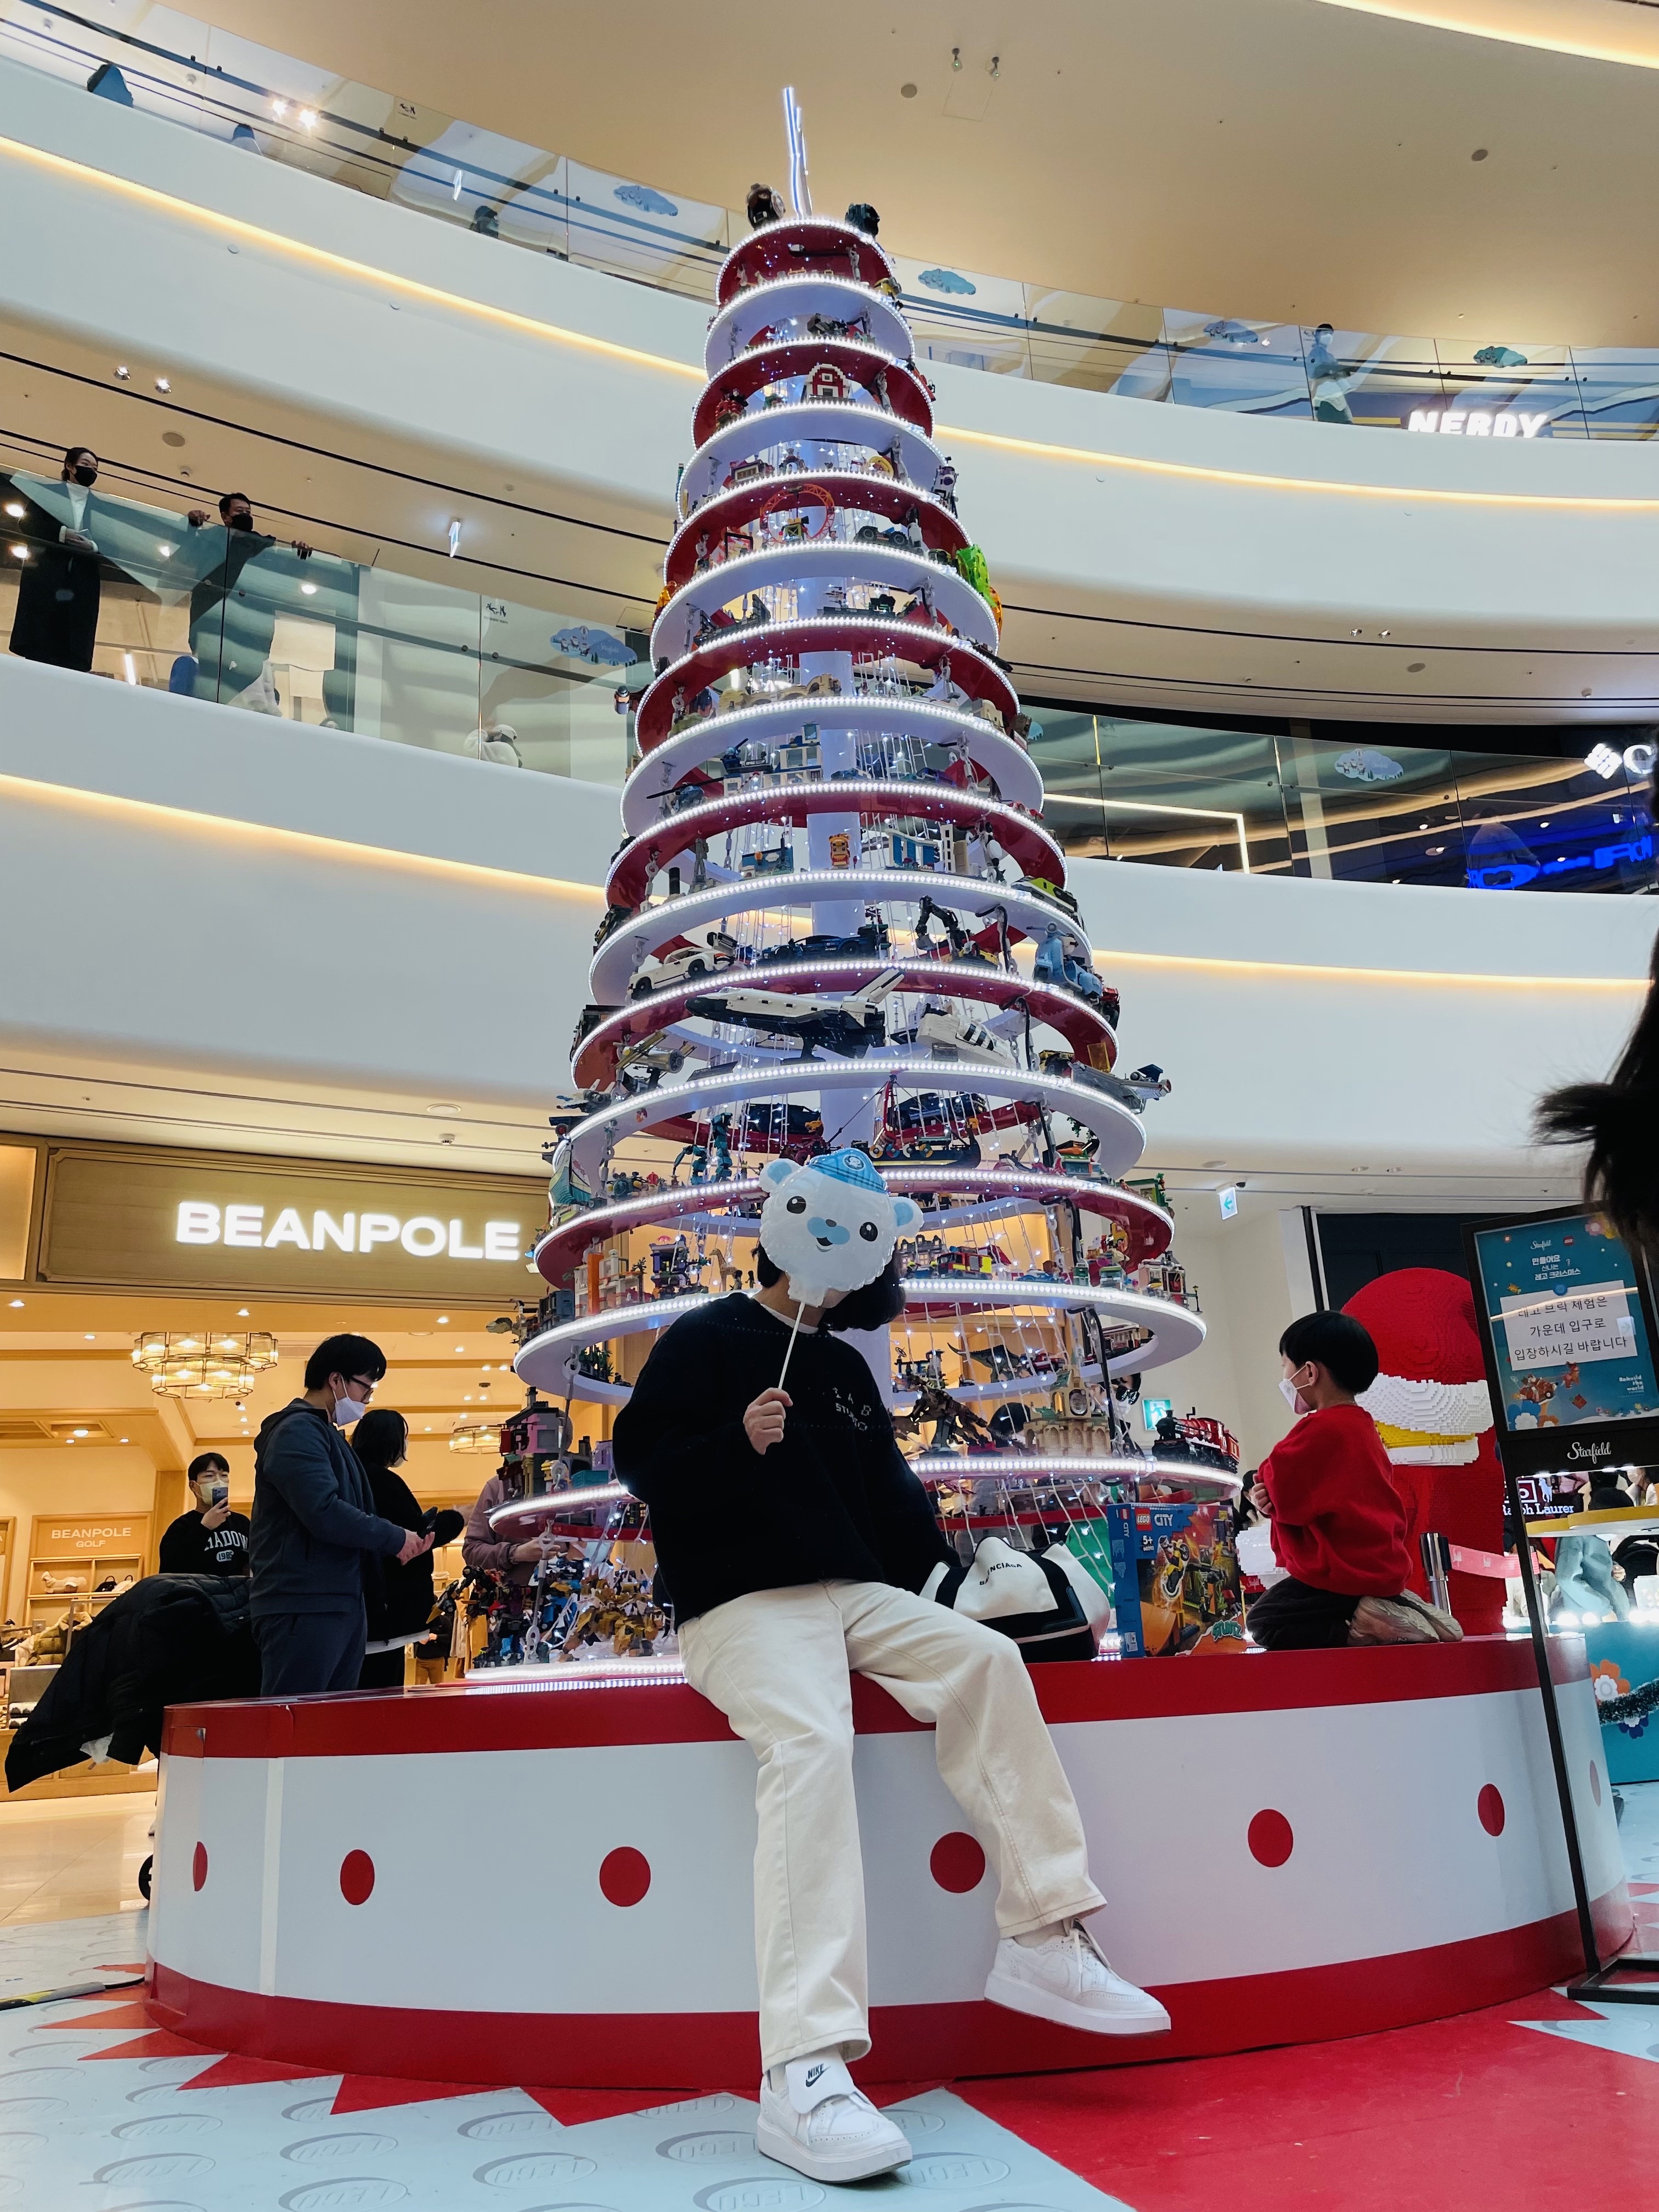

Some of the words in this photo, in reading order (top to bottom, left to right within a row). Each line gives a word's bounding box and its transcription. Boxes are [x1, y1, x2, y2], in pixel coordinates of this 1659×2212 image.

[1408, 411, 1547, 438] NERDY
[176, 1202, 521, 1261] BEANPOLE
[1530, 1322, 1565, 1337] 가운데
[1569, 1318, 1606, 1333] 입구로
[1514, 1342, 1575, 1361] 입장하시길
[1577, 1335, 1627, 1352] 바랍니다
[1567, 1441, 1612, 1464] Starfield
[1136, 1514, 1151, 1524] LEGO
[1154, 1514, 1173, 1526] CITY
[1502, 1504, 1535, 1516] Rah
[51, 1527, 132, 1539] BEANPOLE
[76, 1539, 106, 1548] GOLF
[1143, 1535, 1153, 1545] 5+
[808, 2063, 824, 2080] NIKE
[494, 2158, 578, 2184] LEGO
[906, 2159, 992, 2184] LEGO
[719, 2185, 806, 2212] LEGO
